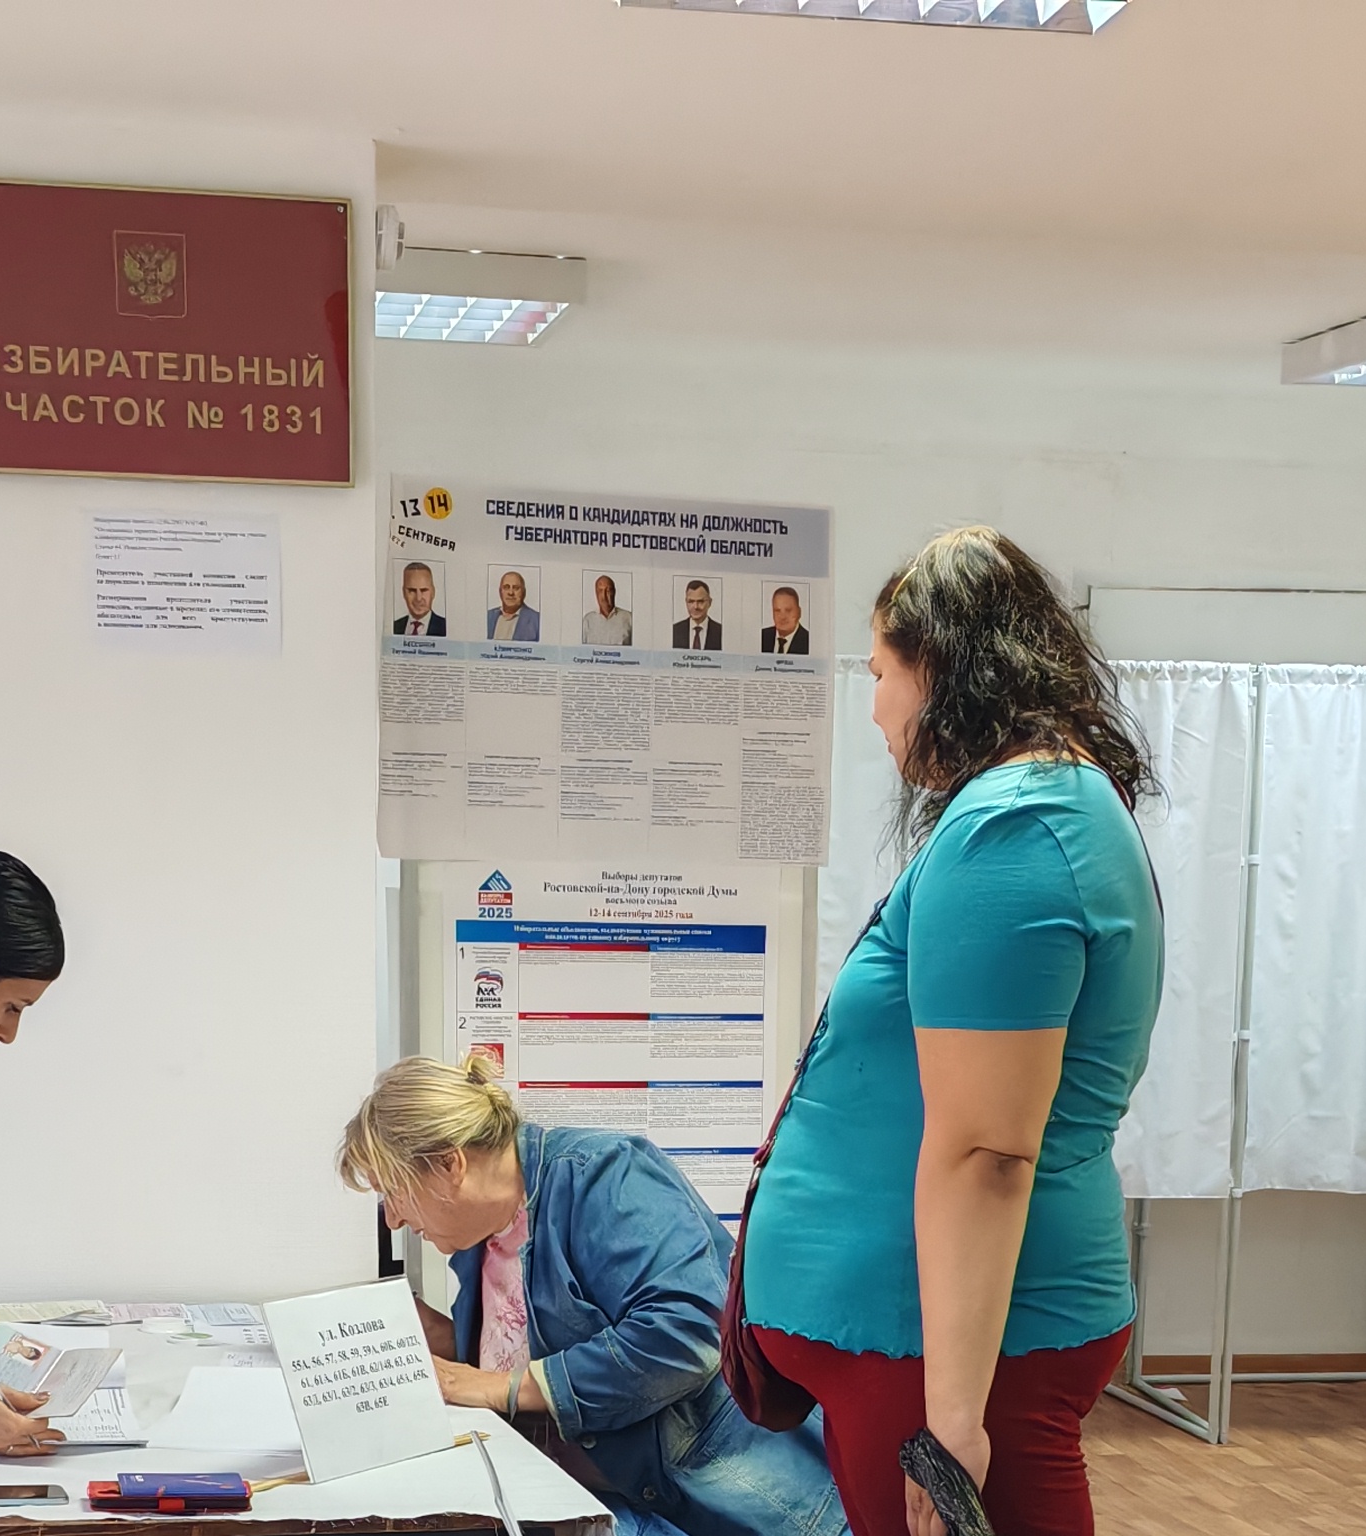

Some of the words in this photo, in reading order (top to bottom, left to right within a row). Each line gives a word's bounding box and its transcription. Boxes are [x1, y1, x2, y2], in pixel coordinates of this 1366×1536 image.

[187, 400, 225, 430] №
[240, 403, 323, 434] 1831
[399, 498, 422, 518] 13
[427, 493, 450, 515] 14
[486, 499, 565, 520] СВЕДЕНИЯ
[568, 504, 579, 521] О
[583, 504, 677, 528] КАНДИДАТАХ
[679, 512, 699, 529] НА
[701, 514, 789, 536] ДОЛЖНОСТЬ
[397, 524, 457, 552] СЕНТЯБРЯ
[505, 525, 608, 548] ГУБЕРНАТОРА
[612, 532, 707, 554] РОСТОВСКОЙ
[710, 539, 774, 558] ОБЛАСТИ
[601, 870, 638, 882] Выборы
[639, 872, 683, 884] депутатов
[543, 881, 650, 897] Ростовской-на-Дону
[652, 884, 705, 897] городской
[706, 885, 738, 899] Думы
[605, 896, 646, 906] восьмого
[646, 897, 677, 907] созыва
[478, 907, 513, 919] 2025
[589, 907, 612, 918] 12-14
[613, 908, 653, 921] сентября
[654, 909, 675, 919] 2025
[675, 910, 694, 920] года
[458, 946, 465, 960] 1
[458, 1016, 467, 1030] 2
[338, 1319, 385, 1338] Козлова
